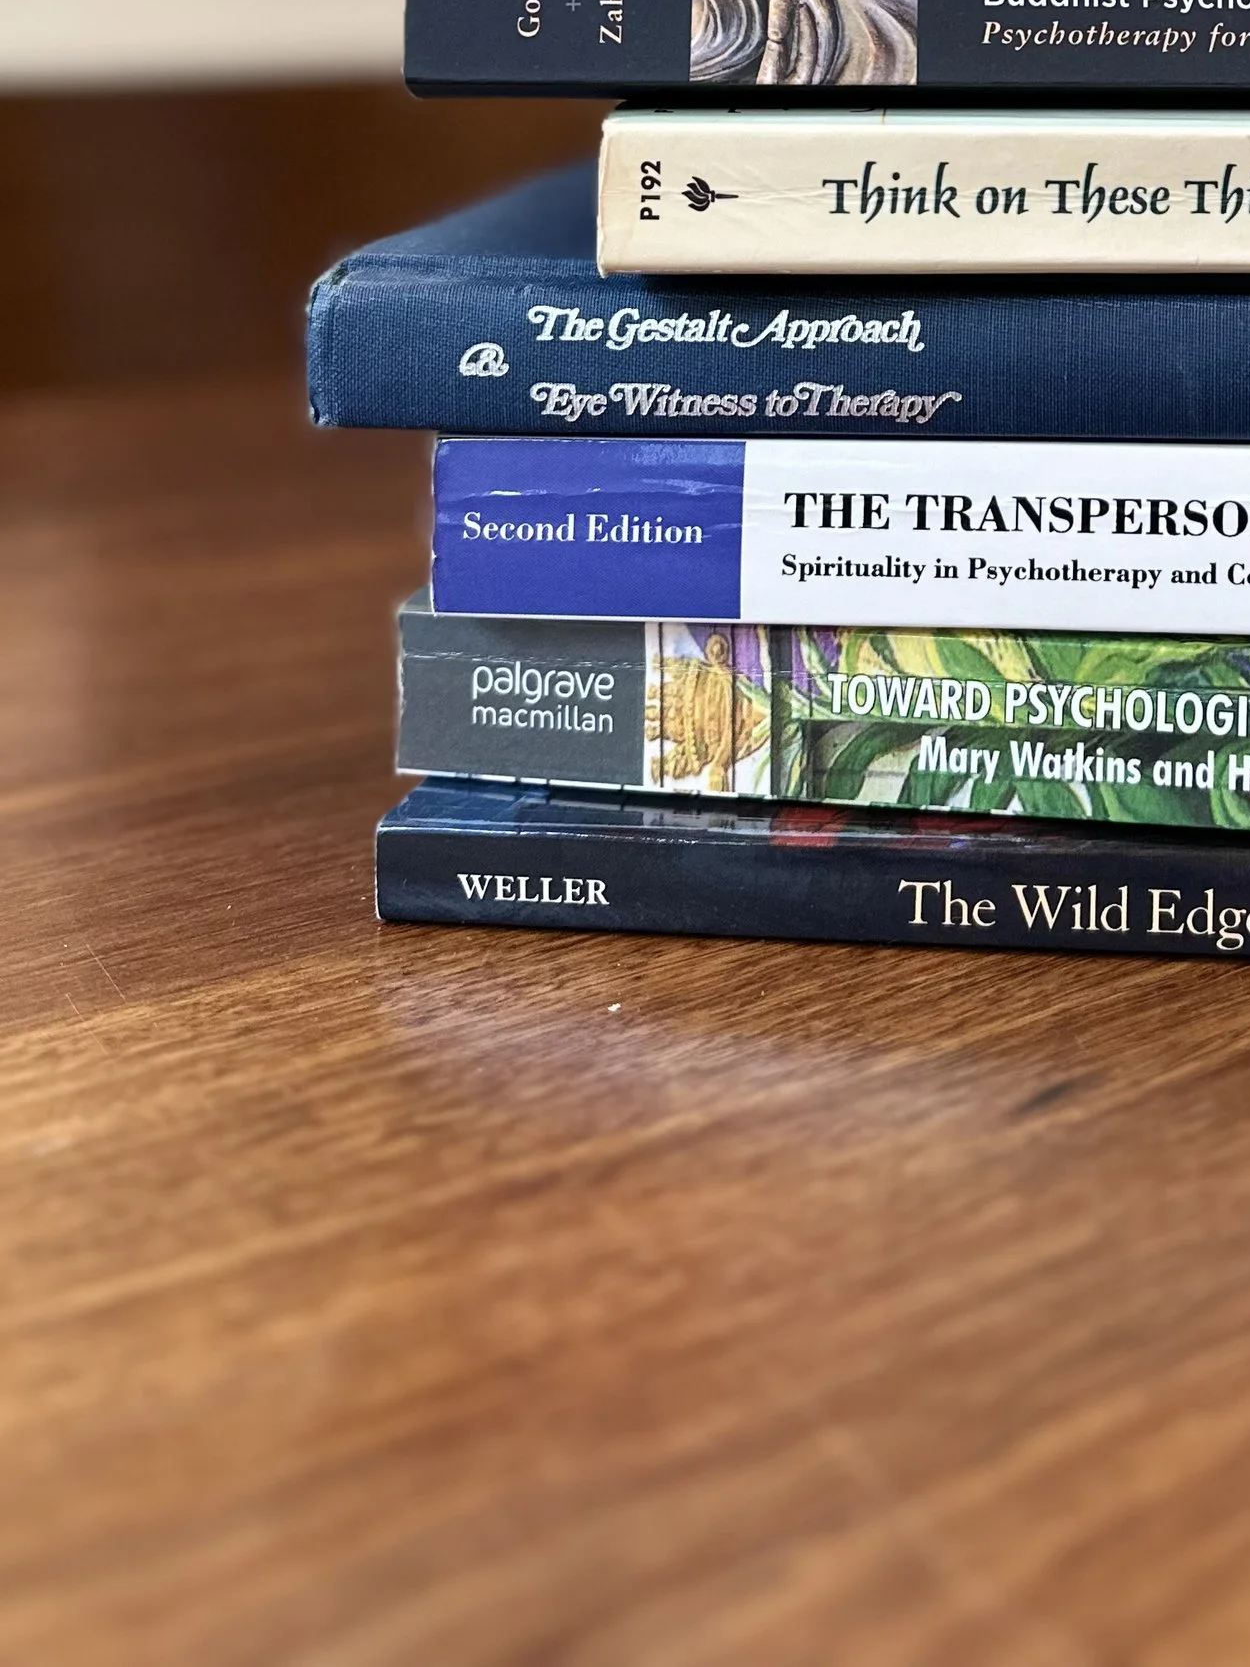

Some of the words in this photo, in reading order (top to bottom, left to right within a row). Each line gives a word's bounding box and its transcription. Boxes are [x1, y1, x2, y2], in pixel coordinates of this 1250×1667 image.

[982, 22, 1197, 54] Psychotherapy
[640, 160, 661, 221] P192
[822, 161, 959, 224] Think
[975, 183, 1027, 214] on
[1044, 163, 1170, 224] These
[528, 305, 605, 341] The
[607, 310, 733, 348] Gestalt
[730, 310, 924, 351] Approach
[459, 343, 509, 377] &
[529, 382, 606, 422] Eye
[609, 383, 757, 418] Witness
[765, 388, 796, 417] to
[794, 385, 961, 425] Therapy
[463, 512, 575, 543] Second
[586, 515, 703, 546] Edition
[784, 491, 891, 531] THE
[781, 555, 926, 584] Spirituality
[933, 559, 959, 580] in
[967, 559, 1164, 589] Psychotherapy
[1171, 563, 1218, 584] and
[472, 662, 615, 704] palgrave
[829, 673, 991, 722] TOWARD
[472, 703, 614, 733] macmillan
[918, 736, 999, 783] Mary
[1010, 740, 1142, 784] Watkins
[1153, 755, 1214, 790] and
[458, 873, 609, 906] WELLER
[898, 880, 996, 928] The
[1012, 883, 1130, 932] Wild
